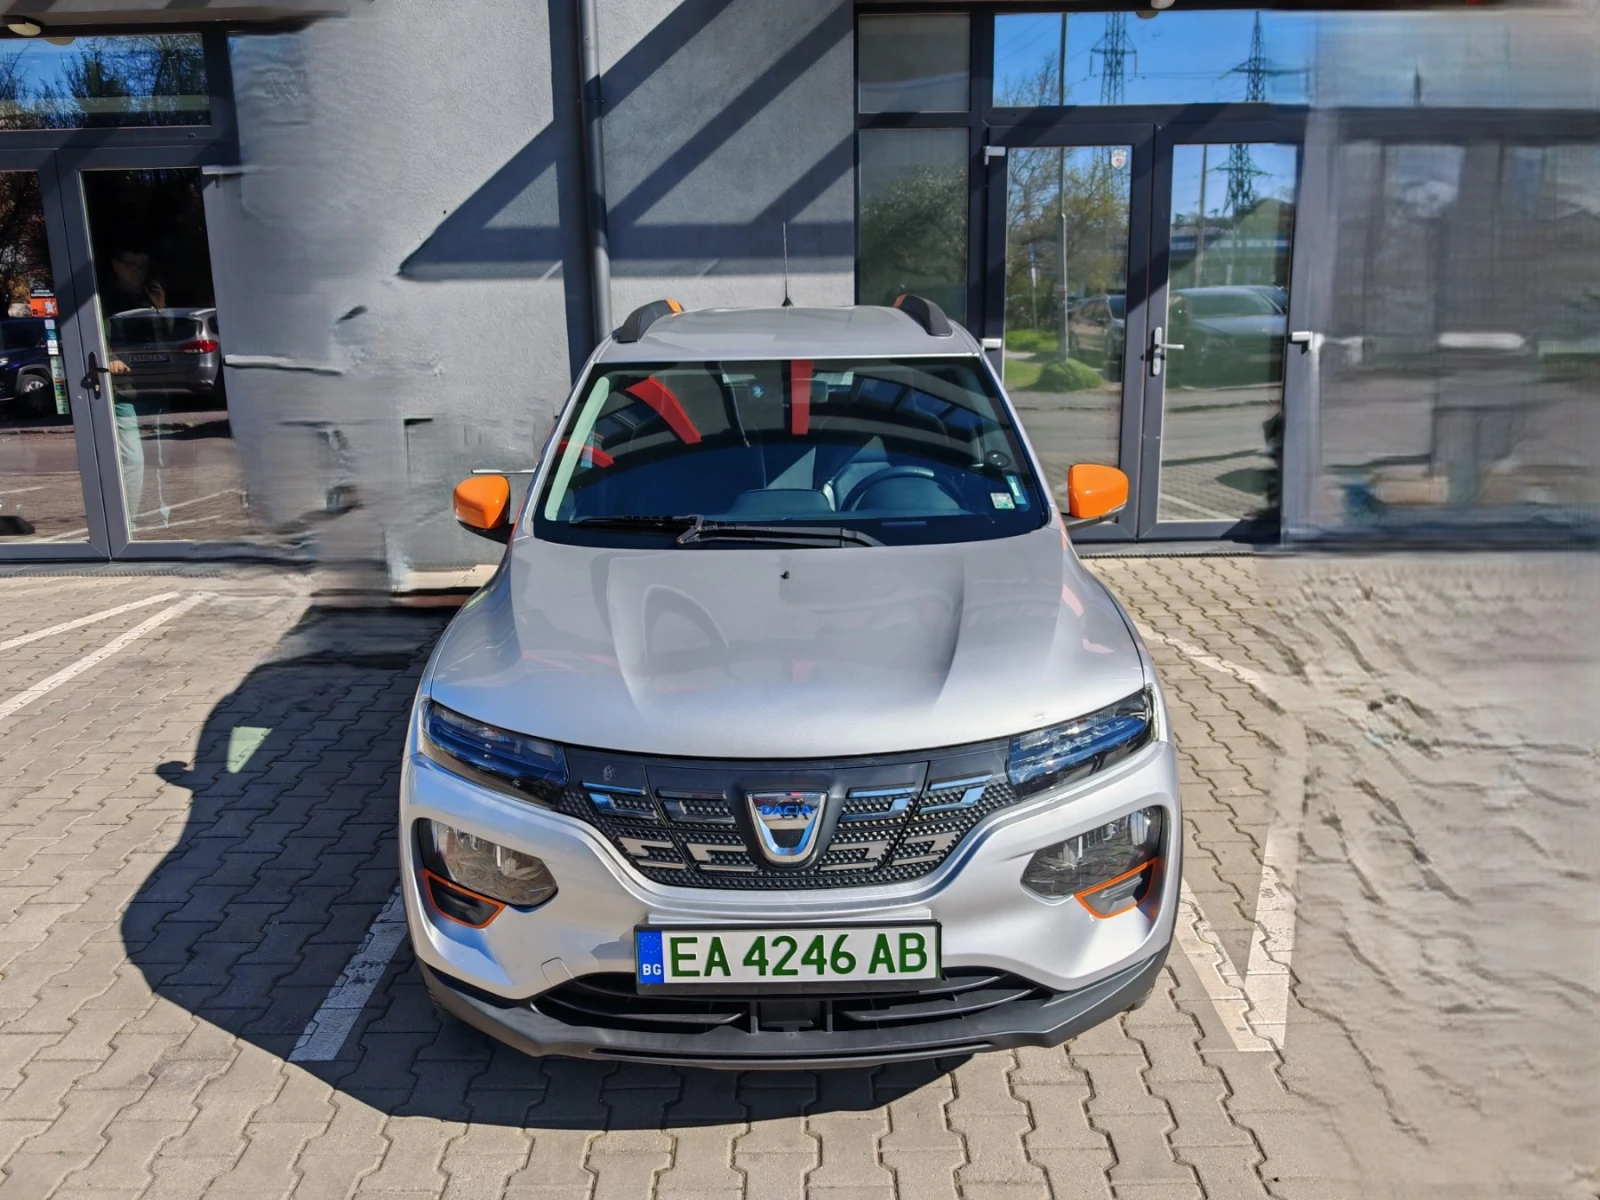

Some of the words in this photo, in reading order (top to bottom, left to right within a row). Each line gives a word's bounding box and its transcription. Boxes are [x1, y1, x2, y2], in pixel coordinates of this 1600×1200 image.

[761, 803, 813, 816] DACIA
[670, 936, 731, 977] EA
[743, 934, 857, 976] 4246
[868, 933, 928, 974] AB
[642, 963, 662, 976] BG
